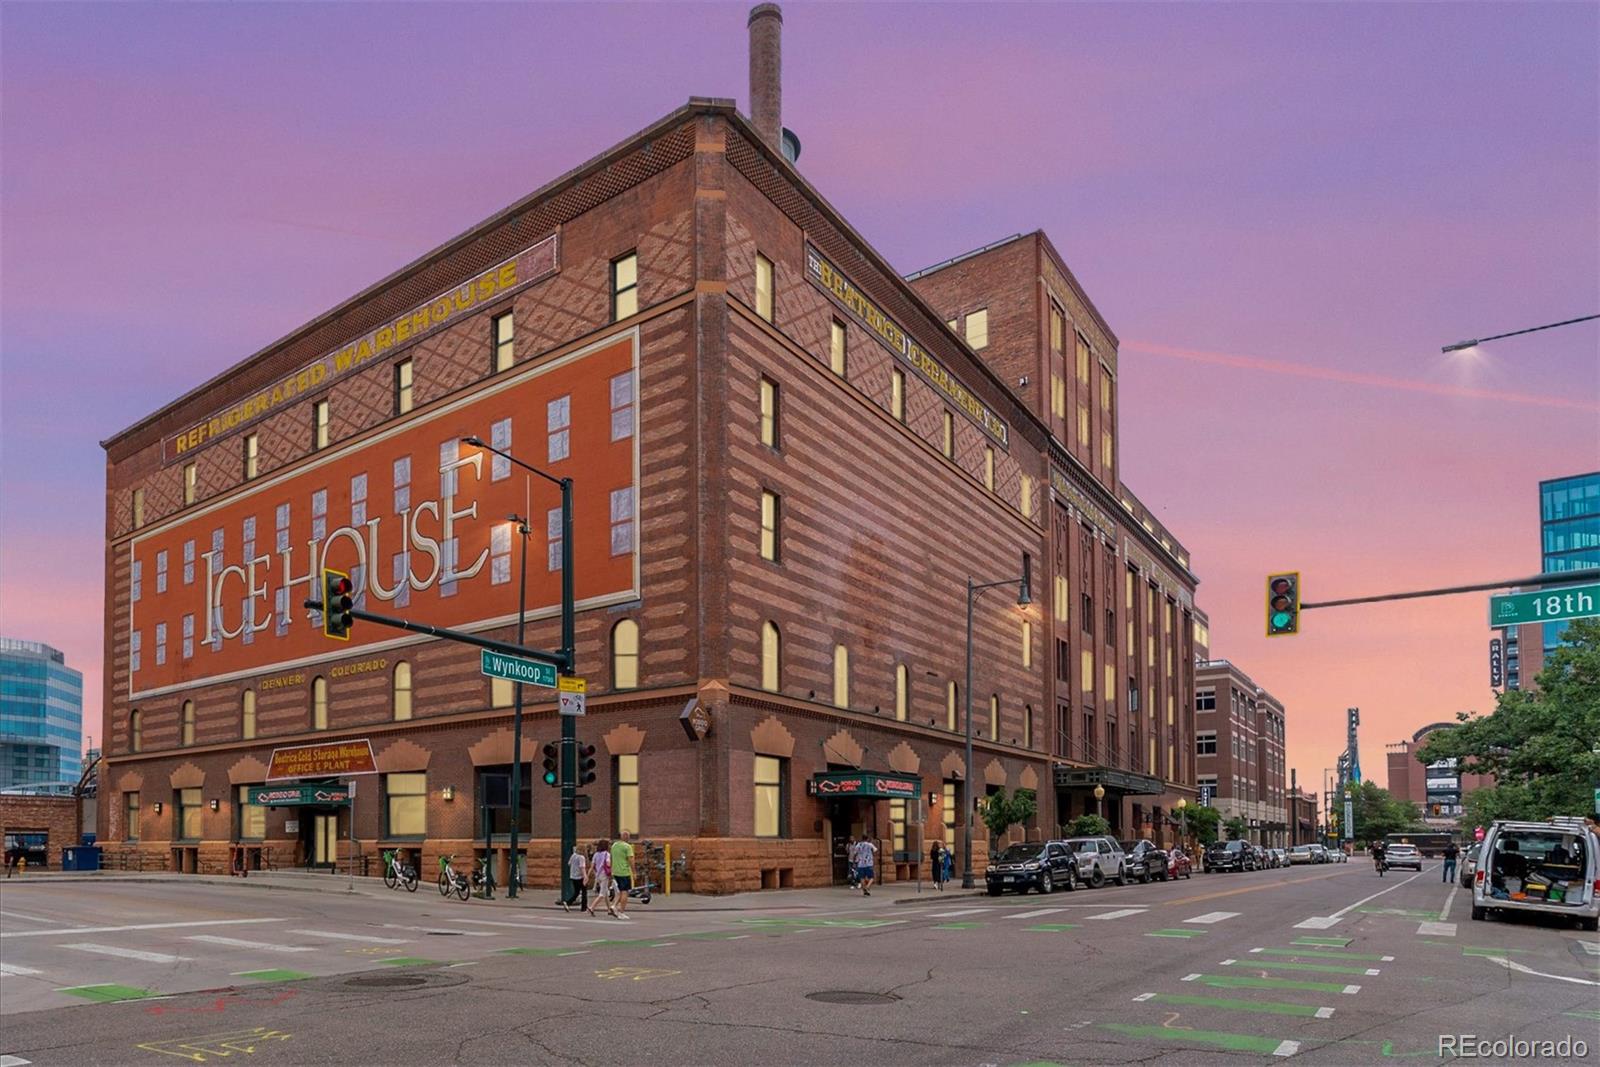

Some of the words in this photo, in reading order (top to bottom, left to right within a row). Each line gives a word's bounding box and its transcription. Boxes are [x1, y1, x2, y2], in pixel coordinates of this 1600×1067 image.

[176, 362, 328, 454] REFRIGERATED
[333, 260, 518, 373] WAREHOUSE
[1532, 592, 1593, 616] 18th
[331, 658, 387, 678] COLORADO
[492, 656, 541, 682] Wynkoop
[1491, 645, 1500, 681] RALLY
[262, 674, 304, 690] DENVER
[287, 763, 313, 773] OFFICE
[323, 760, 351, 770] PLANT
